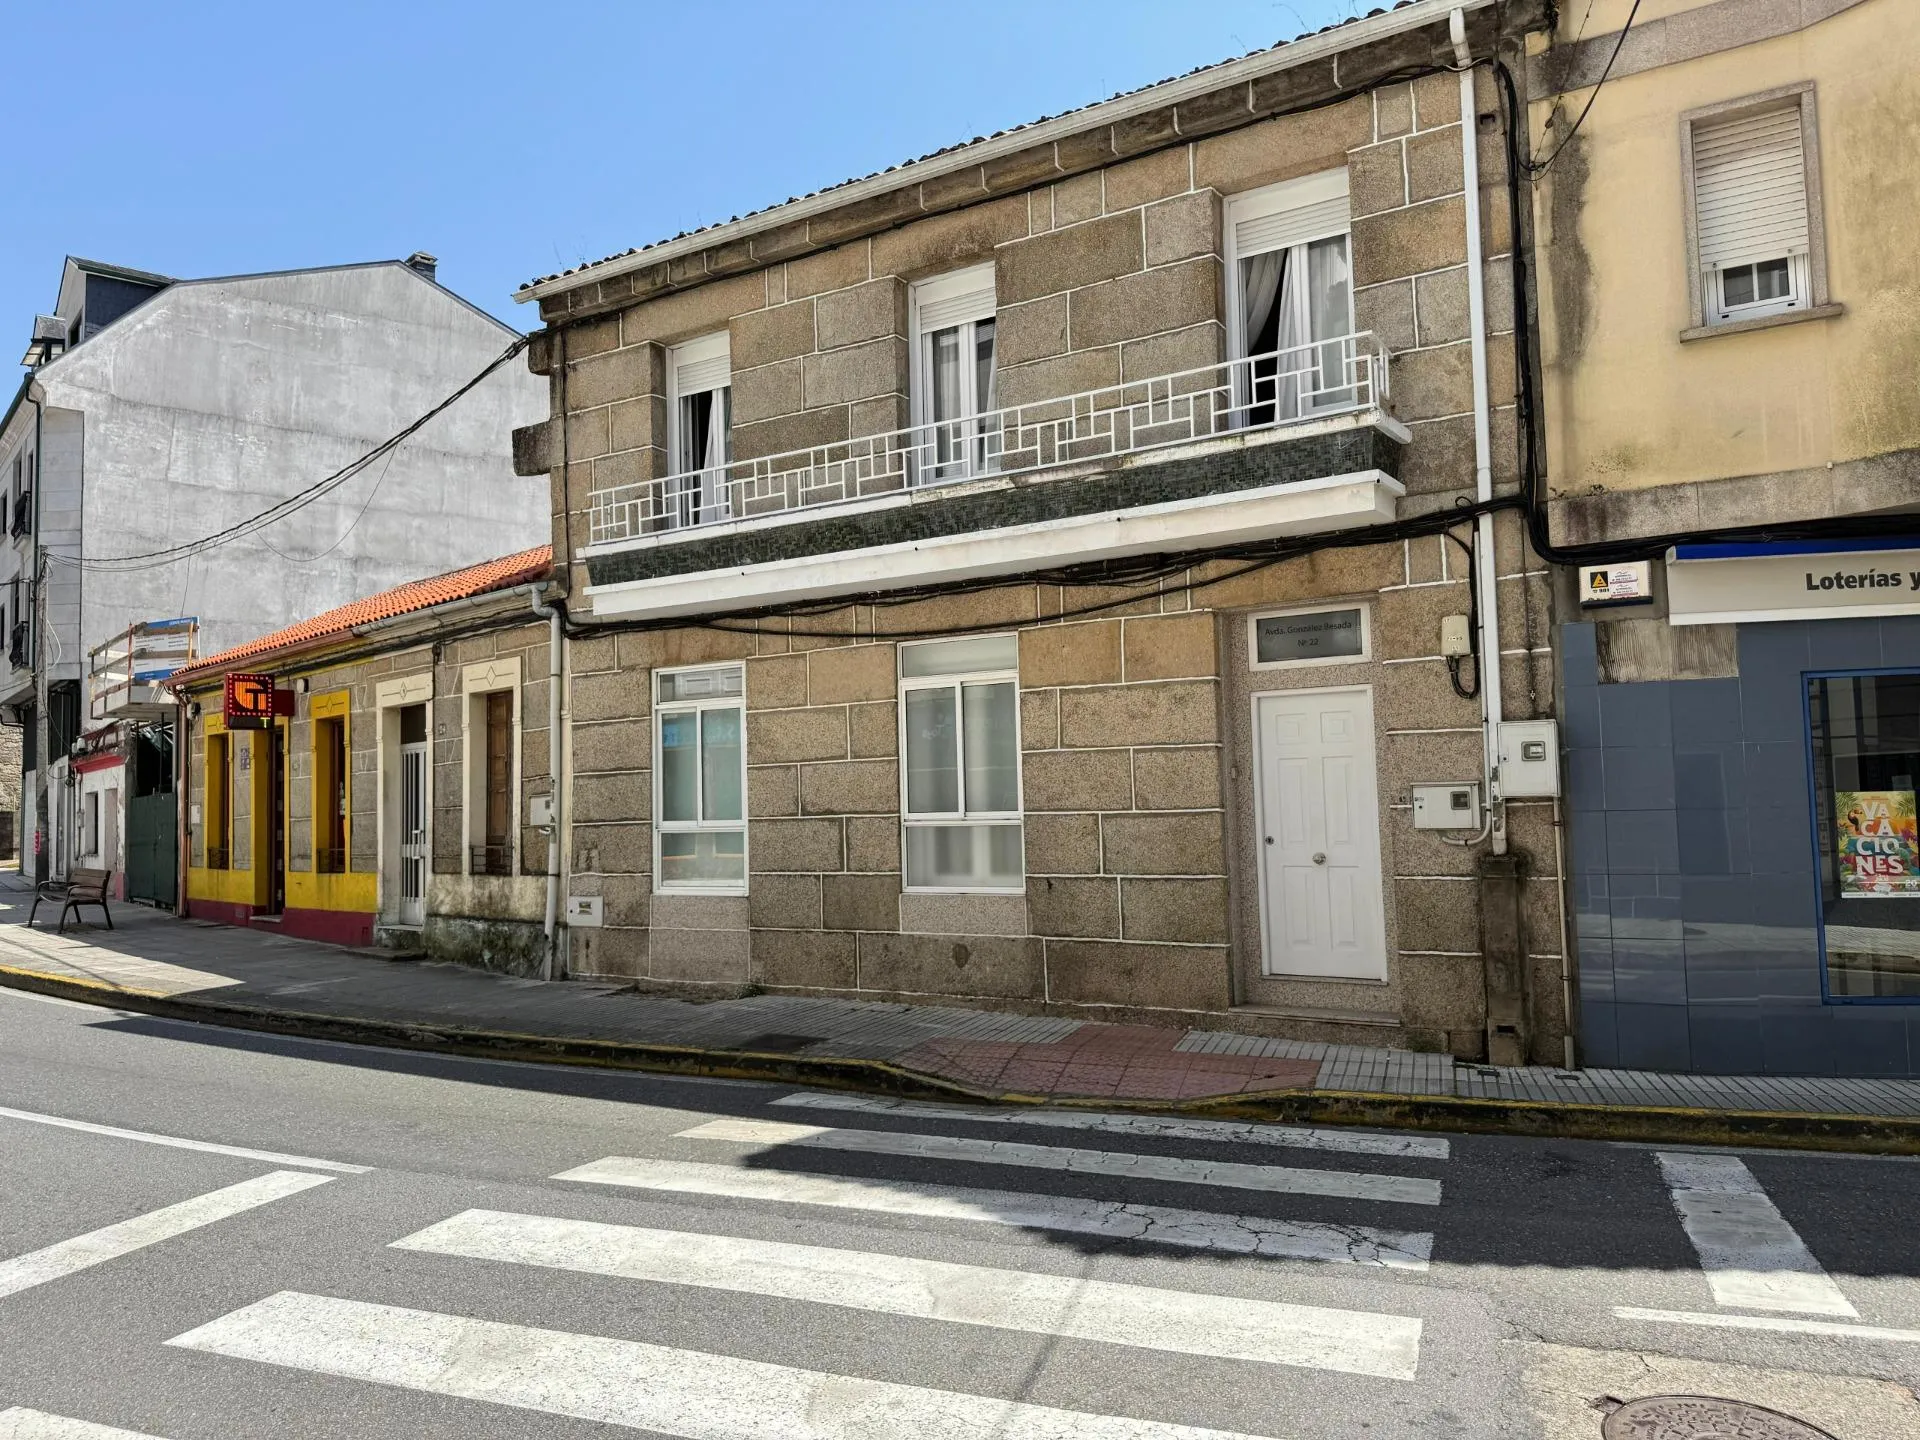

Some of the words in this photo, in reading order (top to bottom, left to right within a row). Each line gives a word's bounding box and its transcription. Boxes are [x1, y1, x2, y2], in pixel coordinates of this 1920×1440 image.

[1805, 568, 1903, 591] Loterías
[1909, 571, 1920, 591] y
[1323, 620, 1352, 631] Besada
[1308, 638, 1319, 646] 22
[1861, 801, 1890, 820] VA
[1860, 819, 1895, 837] CA
[1856, 837, 1900, 855] CIO
[1855, 855, 1904, 875] NES
